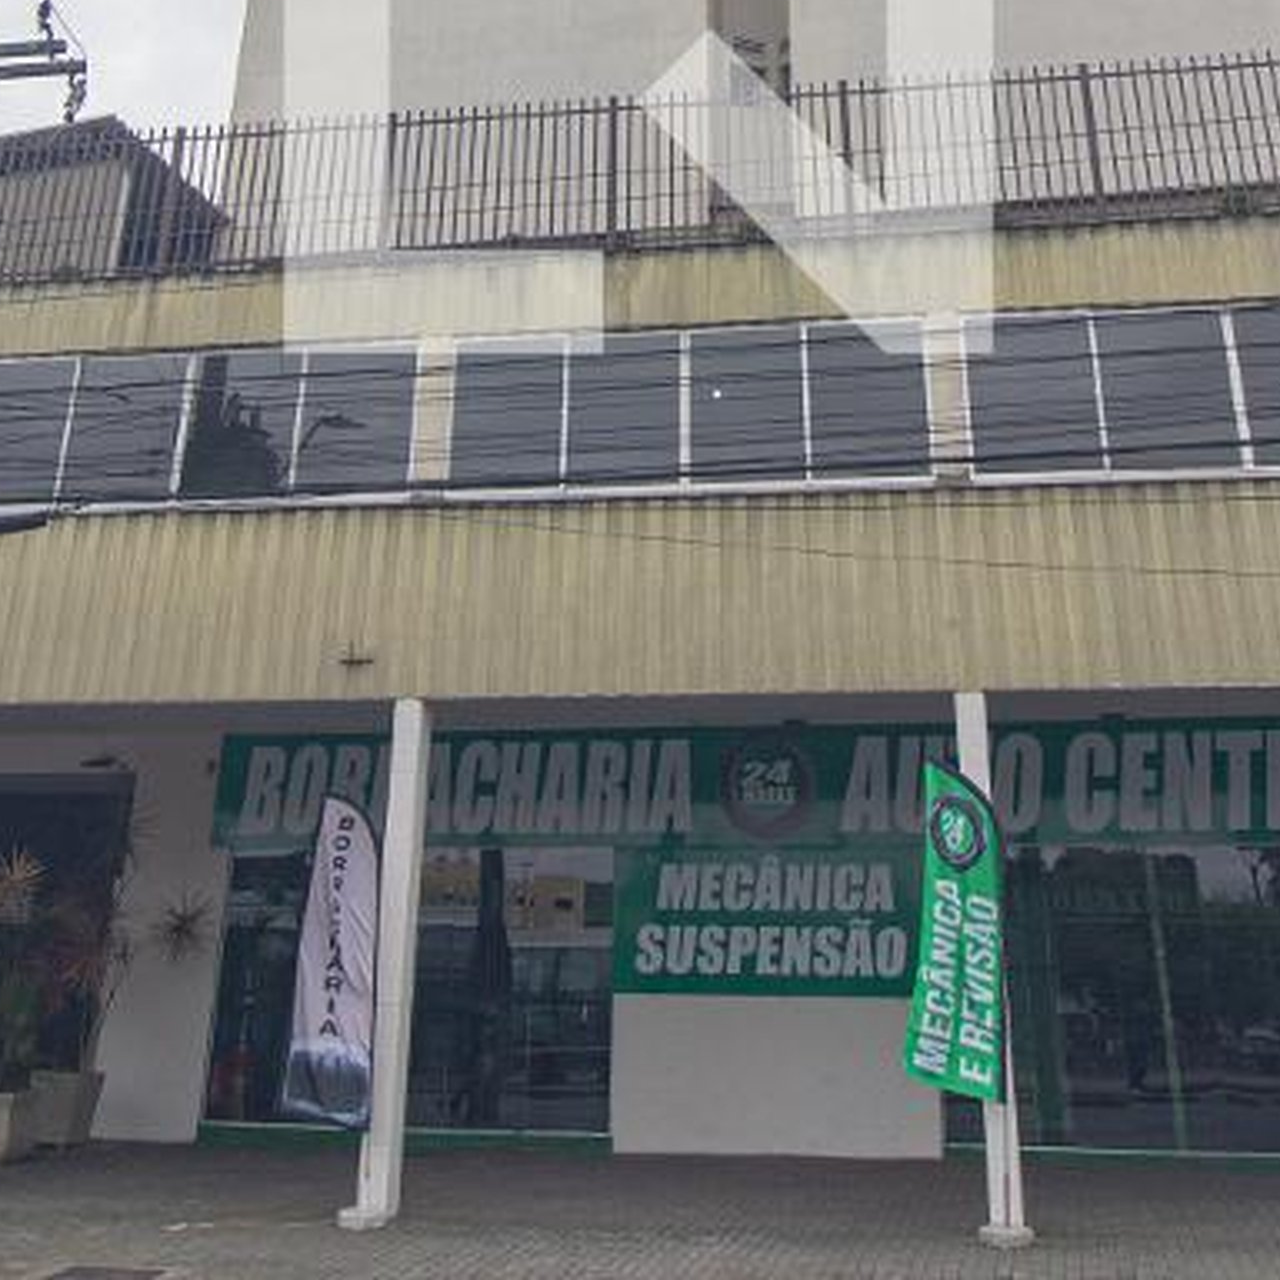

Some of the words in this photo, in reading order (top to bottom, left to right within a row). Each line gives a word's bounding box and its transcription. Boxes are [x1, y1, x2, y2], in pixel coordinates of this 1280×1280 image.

[838, 733, 1044, 834] AUO
[656, 855, 895, 911] MECÂNICA
[634, 918, 908, 979] SUSPENSÃO
[913, 878, 962, 1074] MECÂNICA
[959, 894, 999, 1054] REVISÃO
[959, 1055, 994, 1086] E
